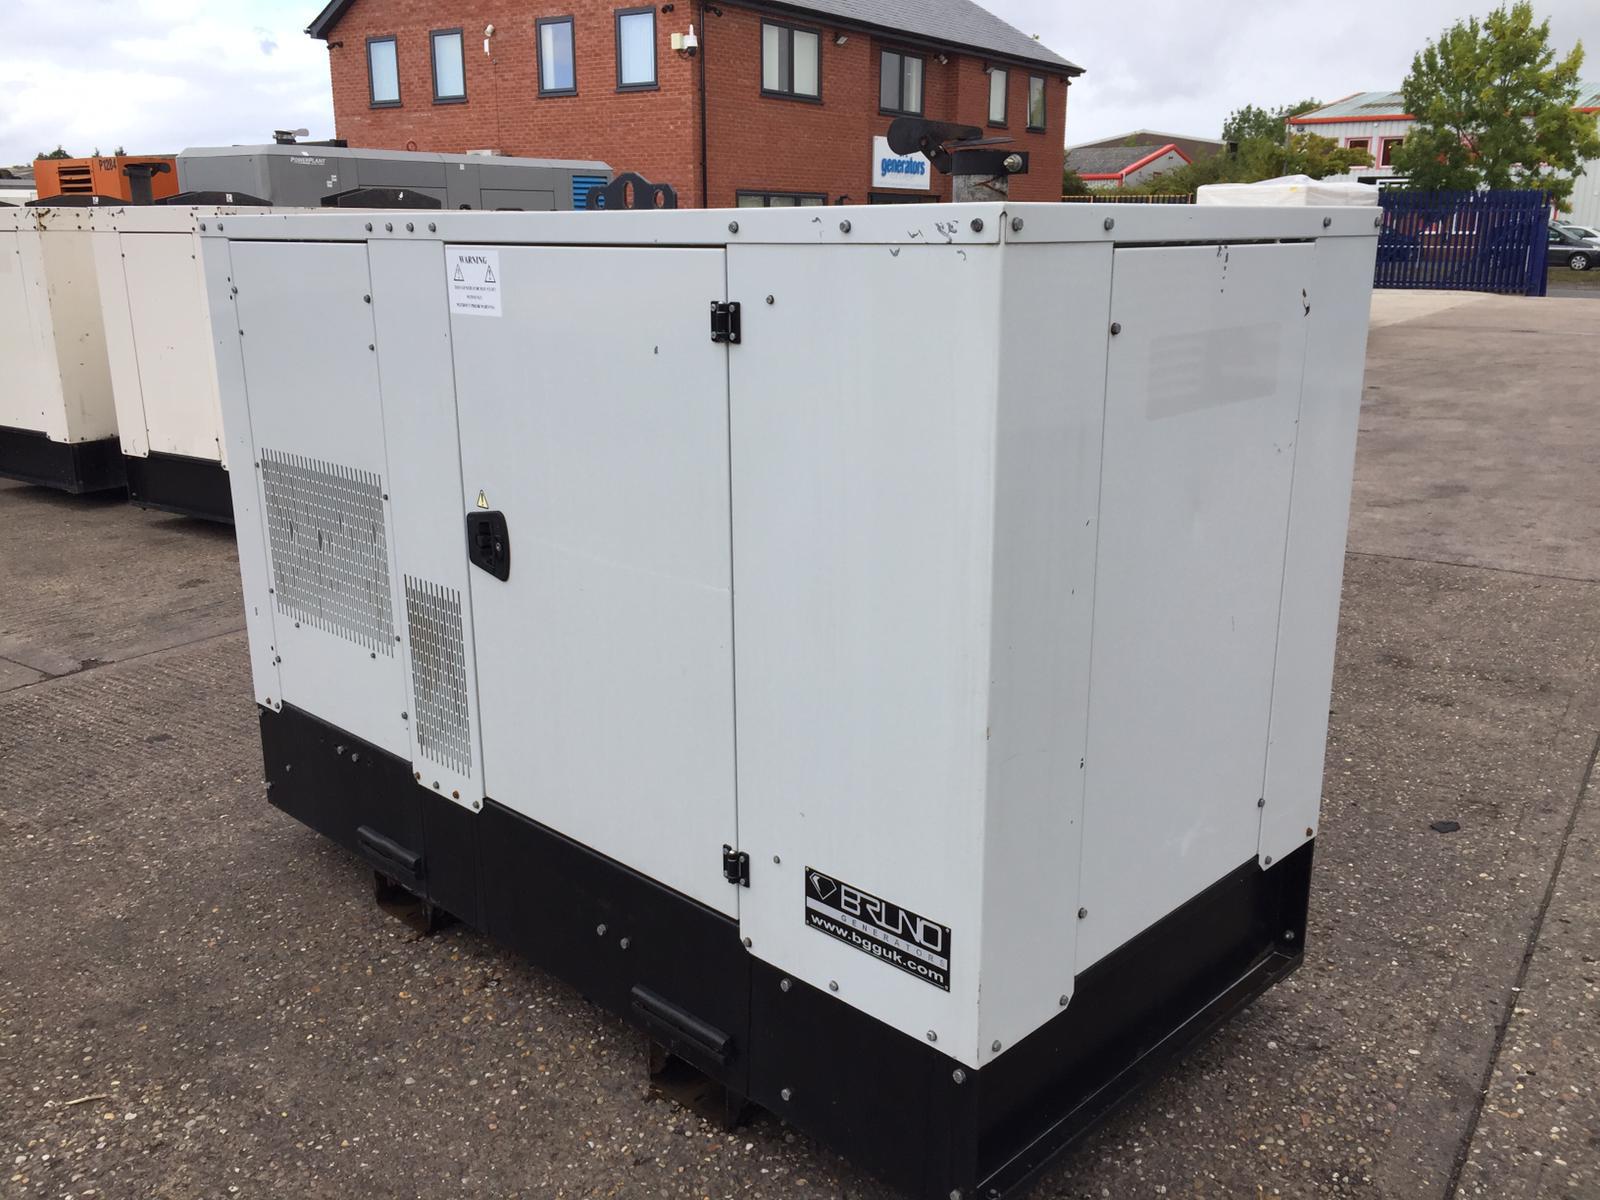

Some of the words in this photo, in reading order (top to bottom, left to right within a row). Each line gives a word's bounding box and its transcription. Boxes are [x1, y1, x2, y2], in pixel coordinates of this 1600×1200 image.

[881, 157, 925, 176] generators
[458, 255, 487, 264] WARNING
[840, 884, 942, 952] BRUNO
[840, 914, 946, 967] GENERATORS
[811, 914, 944, 983] www.bgguk.com
